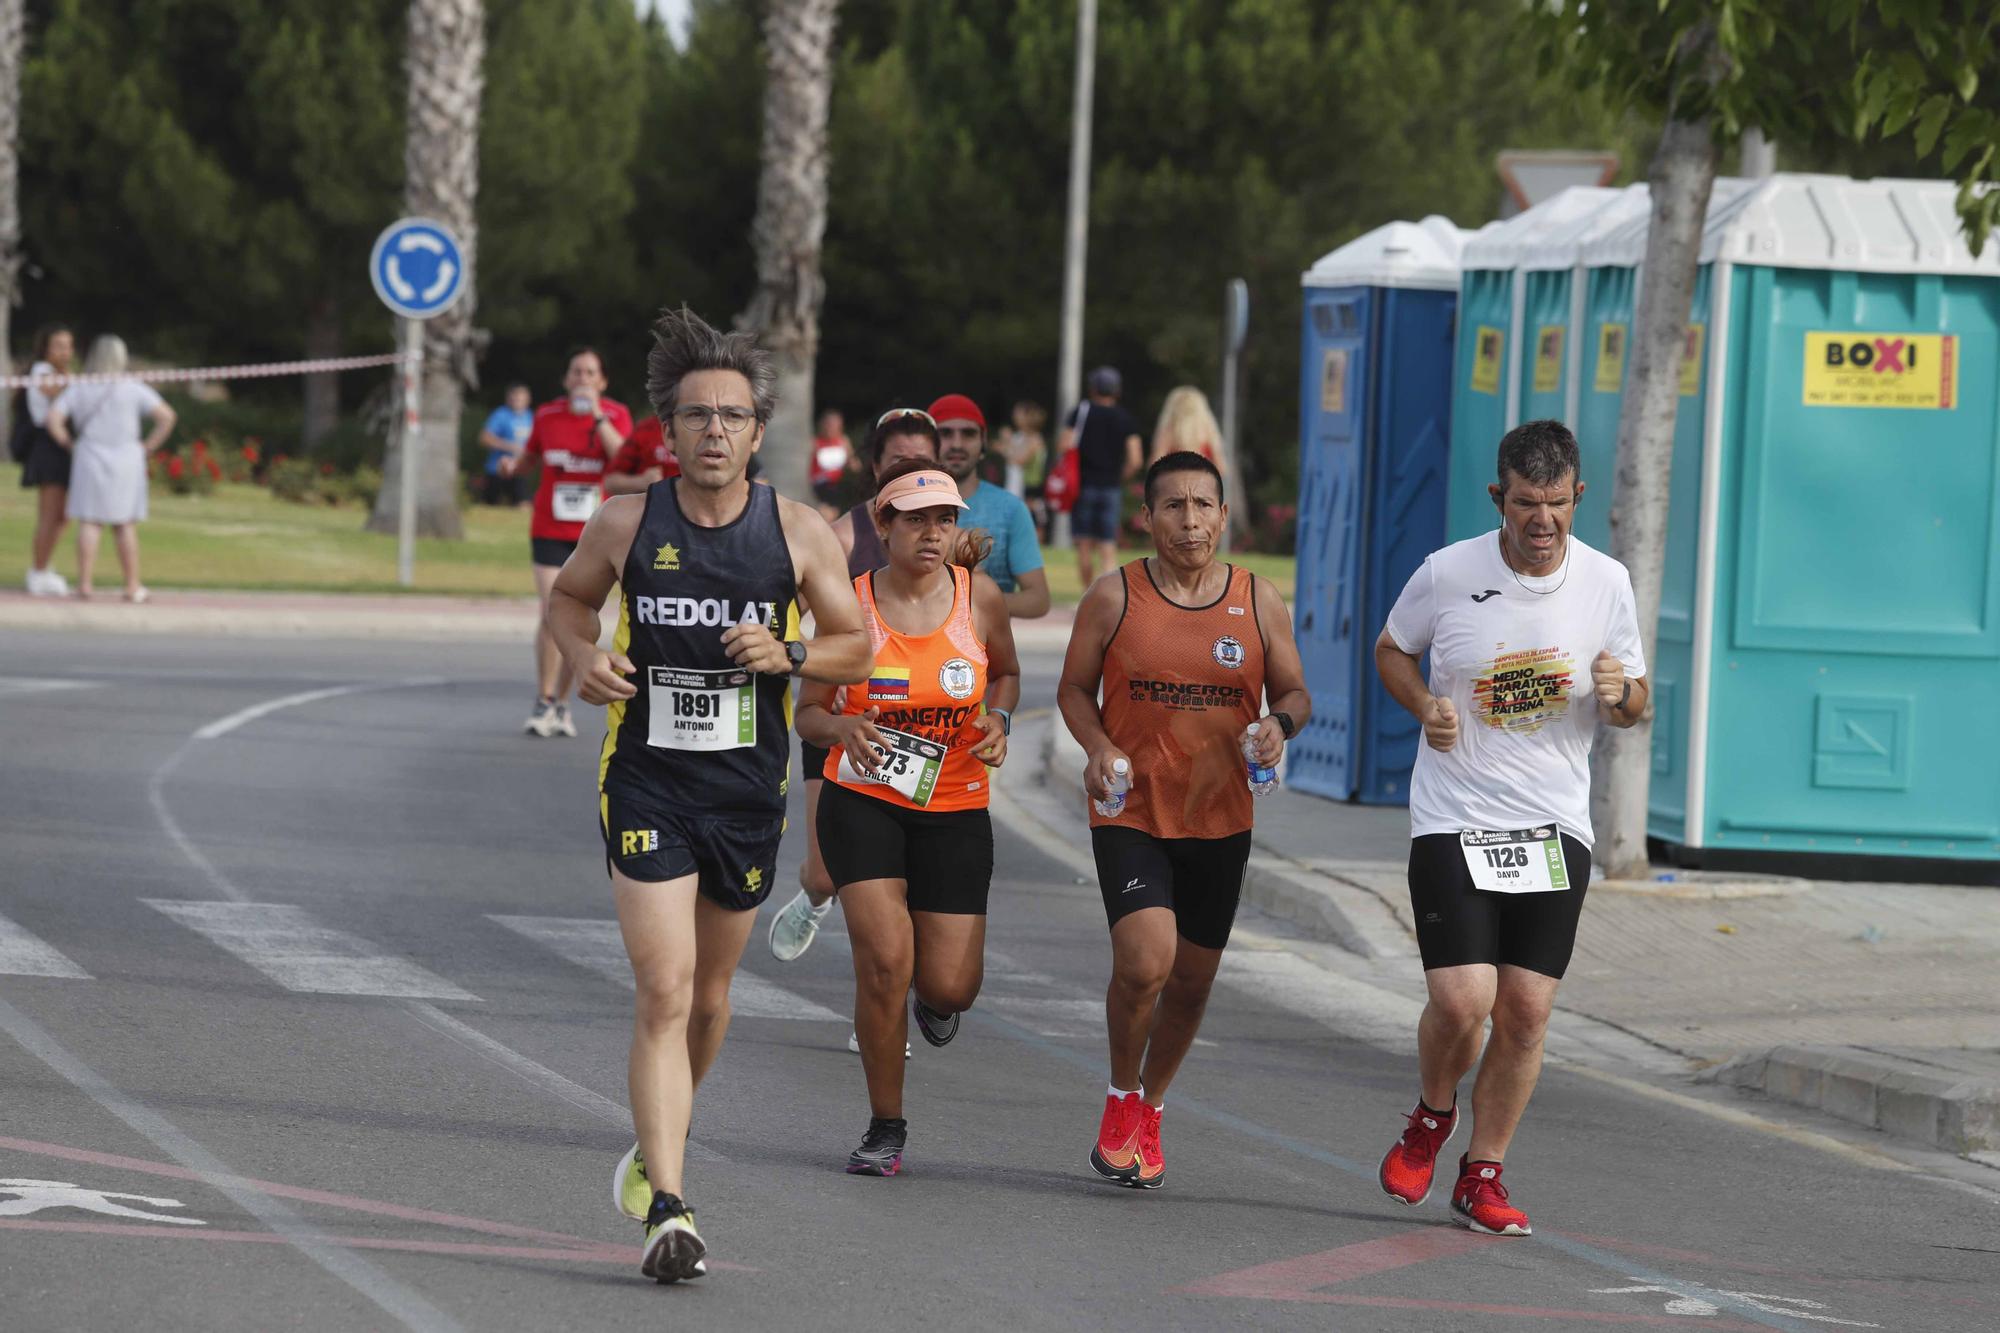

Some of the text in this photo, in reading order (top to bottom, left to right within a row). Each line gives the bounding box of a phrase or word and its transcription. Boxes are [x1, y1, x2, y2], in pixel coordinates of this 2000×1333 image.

[1826, 338, 1916, 373] BOXI
[636, 596, 773, 628] REDOLAT
[1493, 667, 1535, 683] MEDIO
[1130, 681, 1243, 698] PIONEROS
[1493, 674, 1558, 694] MARATÓN
[1513, 689, 1540, 702] VILA
[1543, 686, 1560, 696] DE
[672, 691, 720, 718] 1891
[1491, 698, 1545, 715] PATERNA
[673, 720, 715, 731] ANTONIO
[923, 767, 935, 783] BOX
[1483, 846, 1529, 868] 1126
[1548, 848, 1559, 862] BOX
[1496, 870, 1521, 879] DAVID
